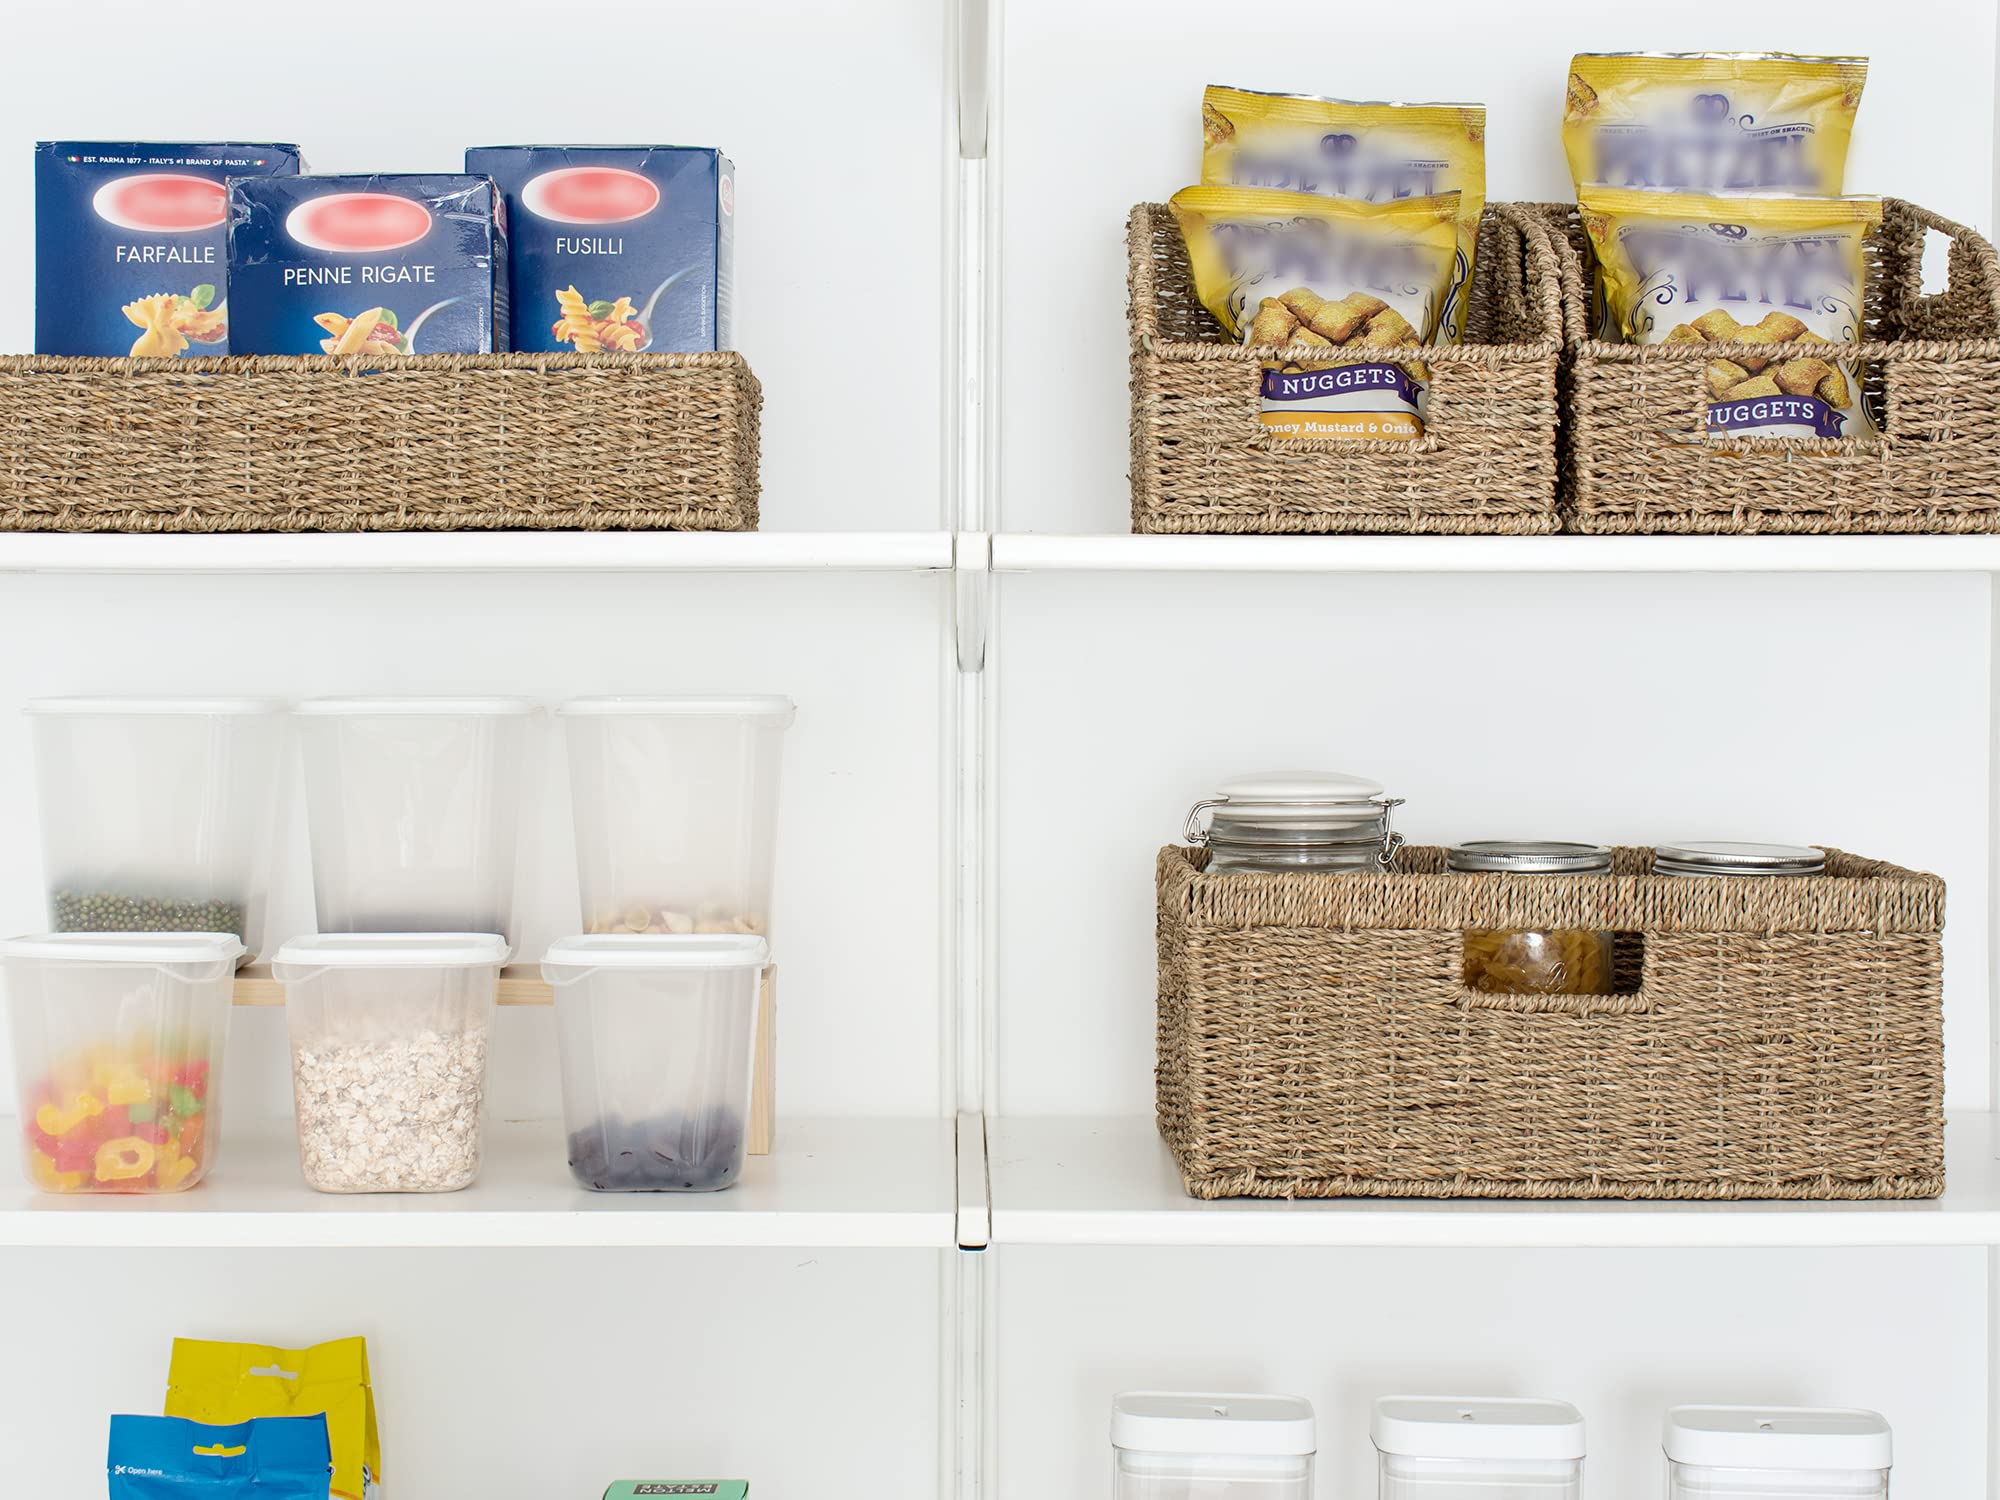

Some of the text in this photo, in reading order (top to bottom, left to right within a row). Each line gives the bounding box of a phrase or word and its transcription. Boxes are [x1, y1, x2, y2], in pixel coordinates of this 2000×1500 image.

[99, 156, 125, 164] PARMA
[126, 157, 142, 165] 1877
[149, 157, 174, 165] ITALY'S
[212, 158, 223, 166] OF
[116, 245, 215, 263] FARFALLE
[556, 237, 623, 255] FUSILLI
[284, 265, 436, 286] PENNE RIGATE
[1282, 368, 1397, 395] NUGGETS
[1260, 422, 1417, 435] oney Mustard & Onio
[127, 1466, 163, 1476] Open here
